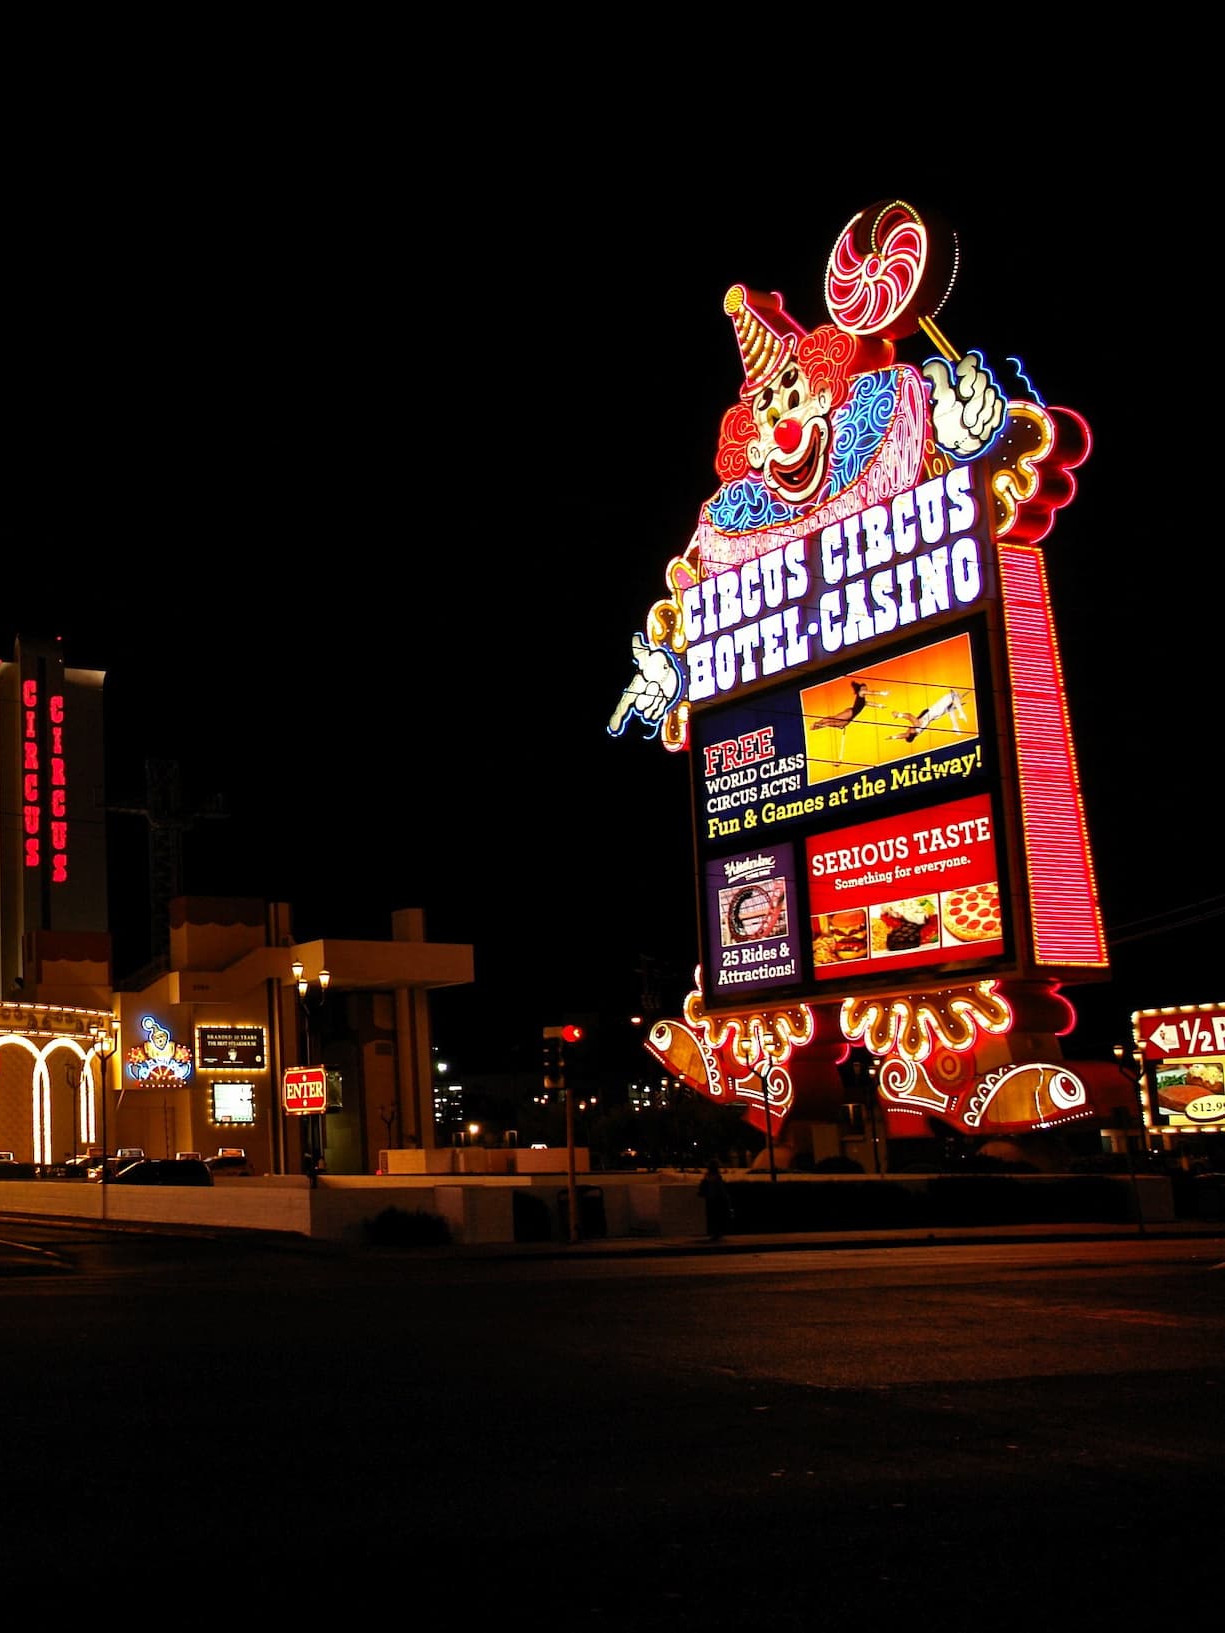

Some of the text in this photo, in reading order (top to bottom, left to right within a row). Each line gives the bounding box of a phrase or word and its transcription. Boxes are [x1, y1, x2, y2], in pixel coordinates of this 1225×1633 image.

[682, 465, 976, 642] CIRCUS CIRCUS
[686, 537, 981, 702] HOTEL CASINO
[23, 680, 39, 866] CIRCUS
[703, 726, 775, 777] FREE
[705, 753, 805, 795] WORLD CLASS
[50, 696, 67, 882] CIRCUS
[707, 774, 801, 813] CIRCUS ACTS!
[708, 745, 982, 839] Fun & Games at the Midway!
[812, 836, 909, 877] SERIOUS
[913, 816, 991, 854] TASTE
[834, 855, 971, 891] Something for everyone.
[717, 958, 796, 986] Attractions!
[722, 942, 790, 967] 25 Rides &
[286, 1081, 324, 1100] ENTER
[1191, 1102, 1225, 1112] $12.9
